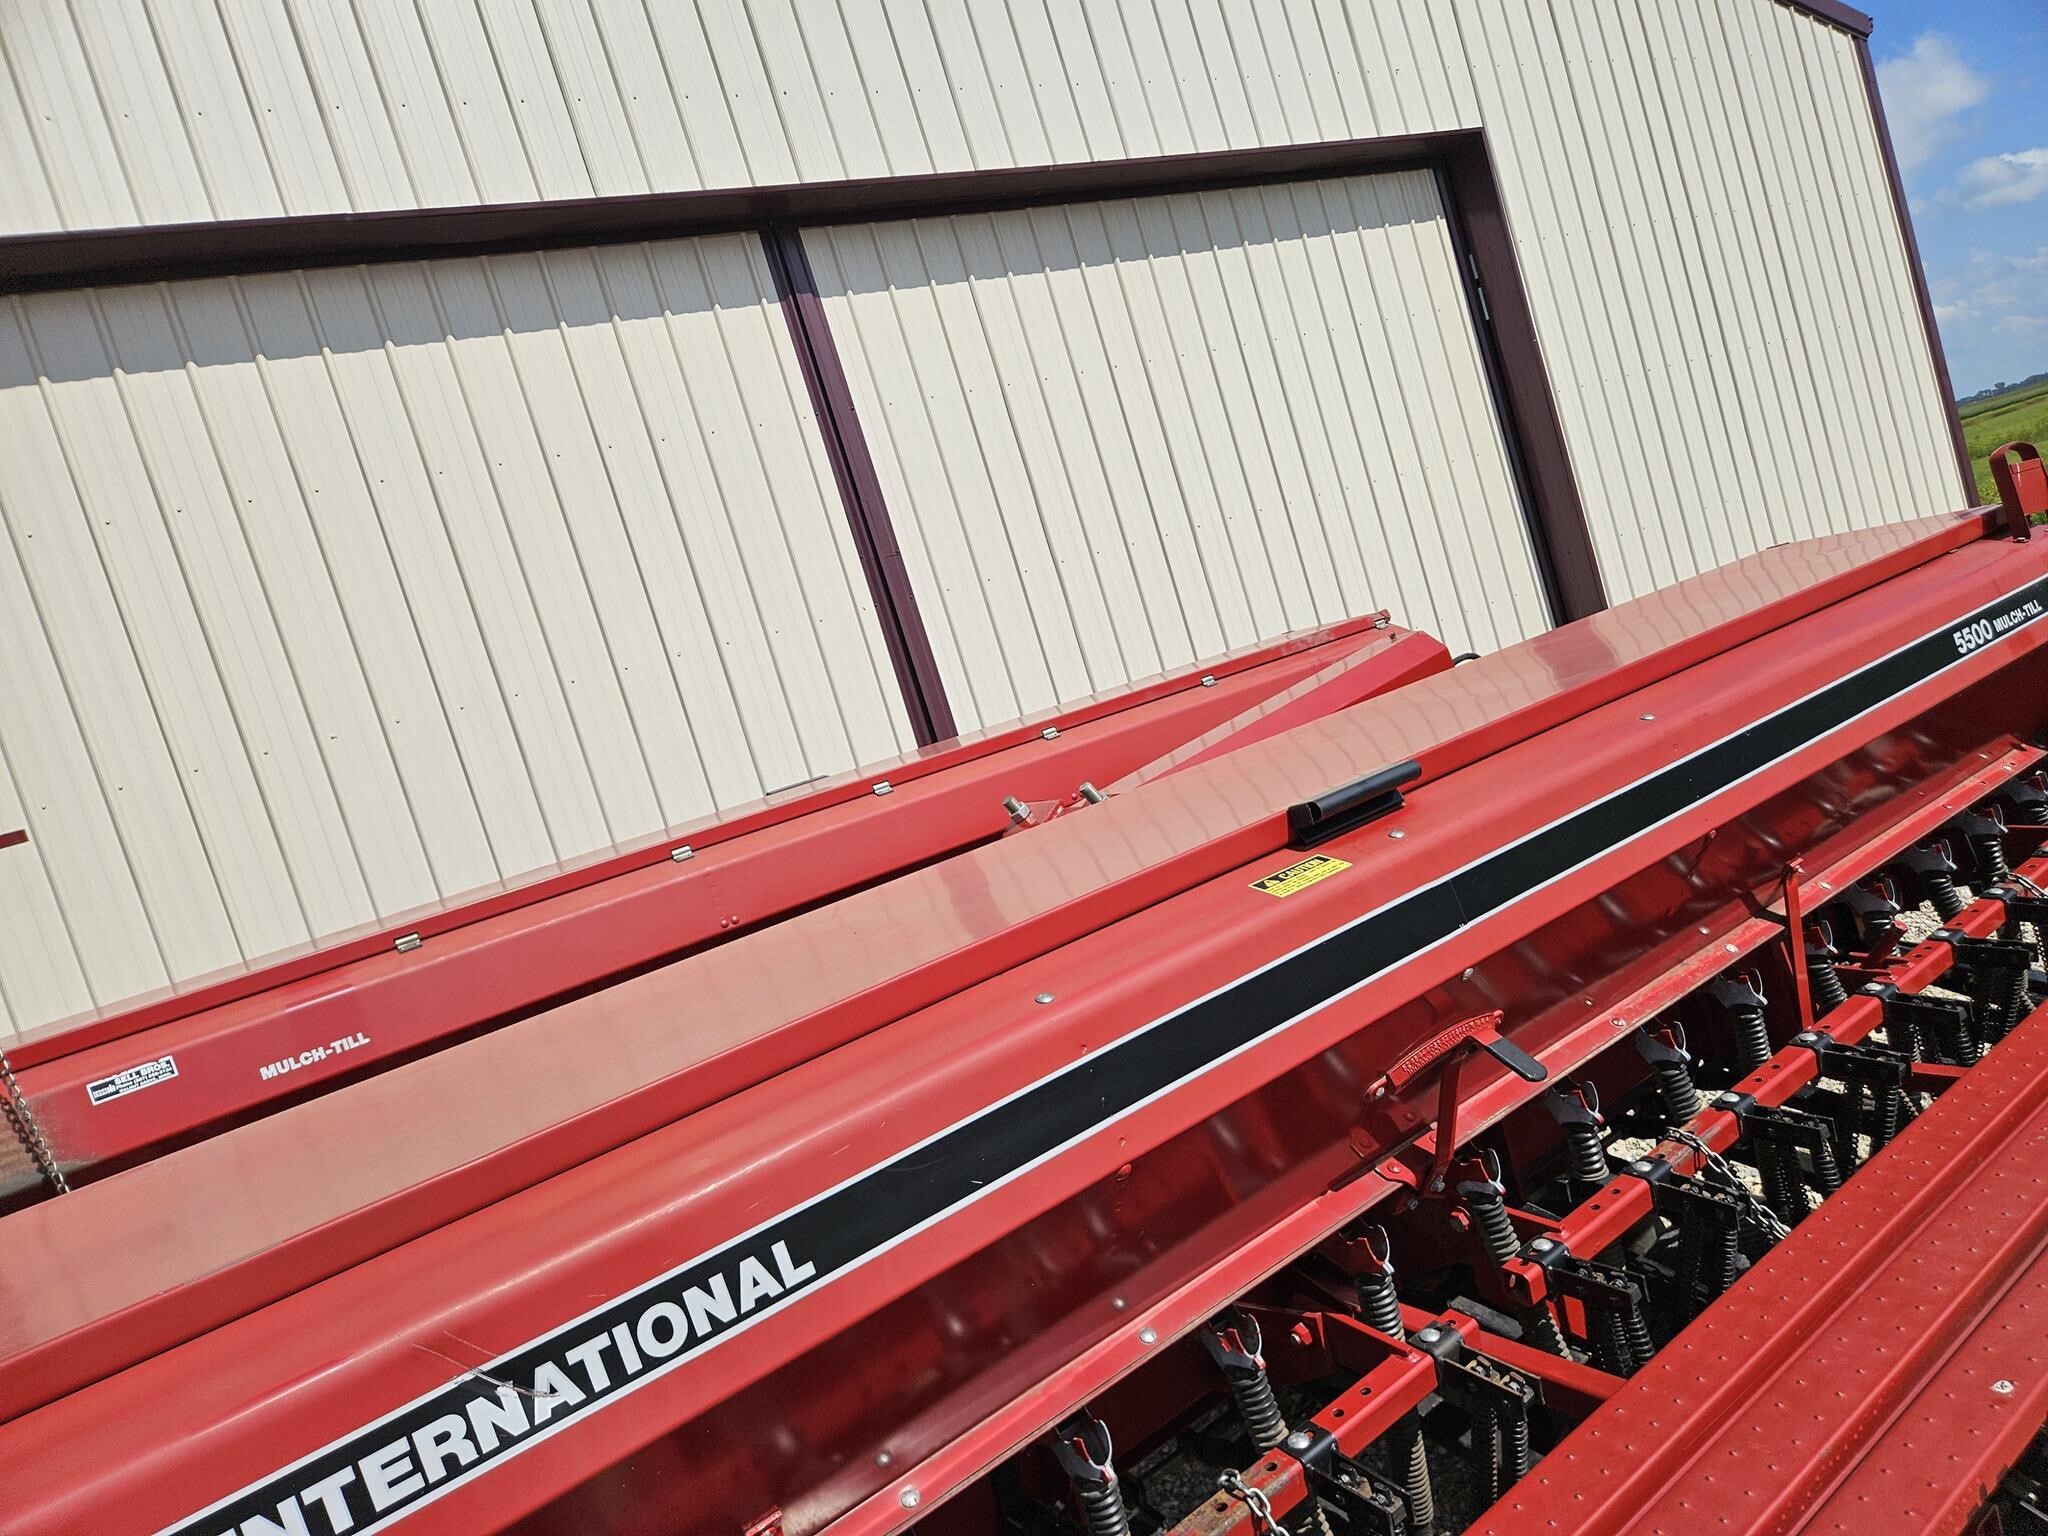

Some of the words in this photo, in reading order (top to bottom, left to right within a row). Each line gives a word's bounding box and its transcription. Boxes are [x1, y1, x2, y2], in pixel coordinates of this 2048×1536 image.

[1953, 618, 1993, 654] 5500
[1992, 599, 2043, 633] MULCH-TILL
[1278, 857, 1324, 879] CAUTION
[114, 1072, 139, 1085] SELL
[260, 1032, 370, 1080] MULCH-TILL
[217, 1239, 816, 1536] NTERNATIONAL
